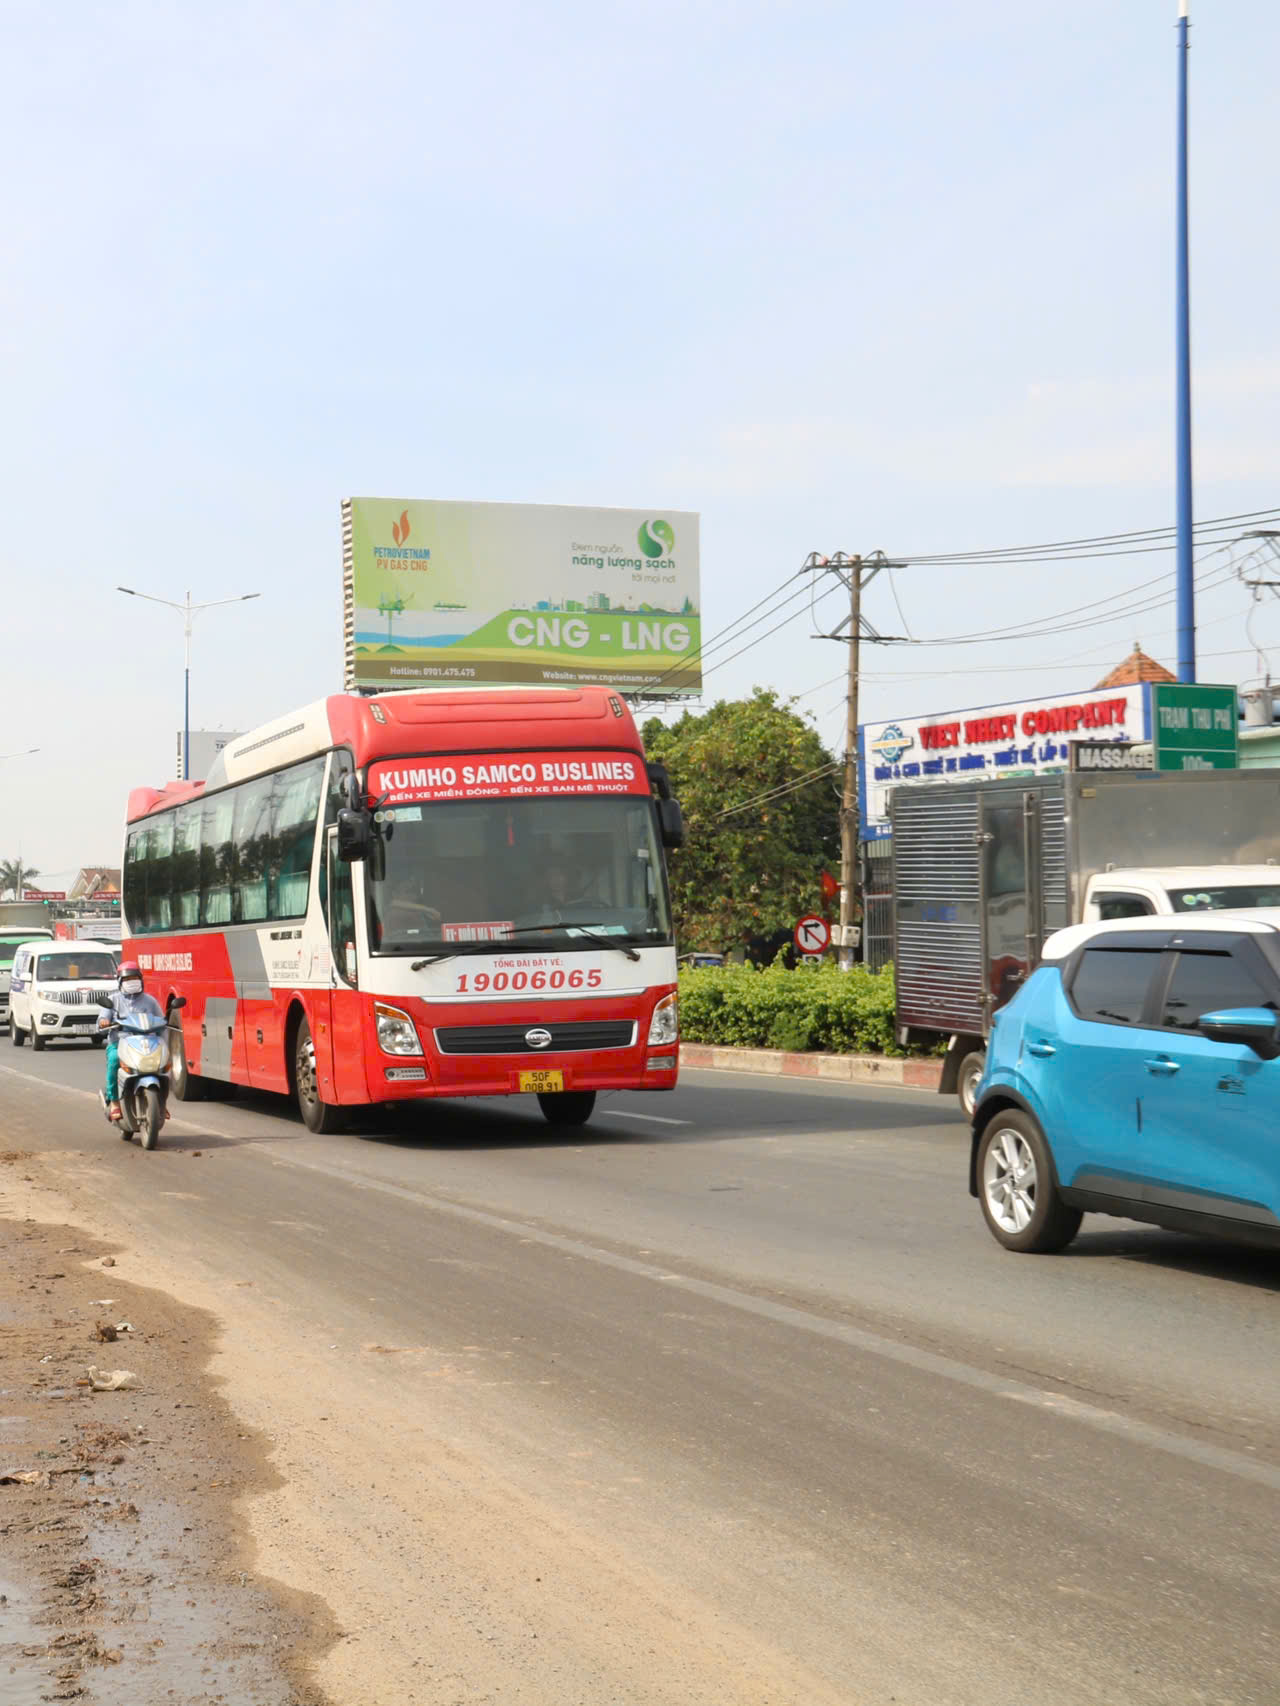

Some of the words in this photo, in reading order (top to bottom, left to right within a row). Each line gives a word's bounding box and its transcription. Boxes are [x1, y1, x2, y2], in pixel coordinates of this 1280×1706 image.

[373, 546, 431, 560] PETROVIETNAM
[572, 554, 604, 569] năng
[608, 556, 642, 571] lượng
[646, 558, 676, 572] sạch
[507, 616, 590, 648] CNG
[622, 621, 691, 651] LNG
[390, 666, 422, 676] Hotline:
[1022, 698, 1127, 737] COMPANY
[1191, 707, 1212, 729] THU
[1078, 747, 1153, 768] MASSAGE
[379, 767, 457, 791] KUMHO
[462, 763, 536, 785] SAMCO
[541, 762, 635, 781] BUSLINES
[416, 791, 431, 799] XE
[456, 969, 602, 993] 19006065
[531, 1071, 550, 1082] 50F
